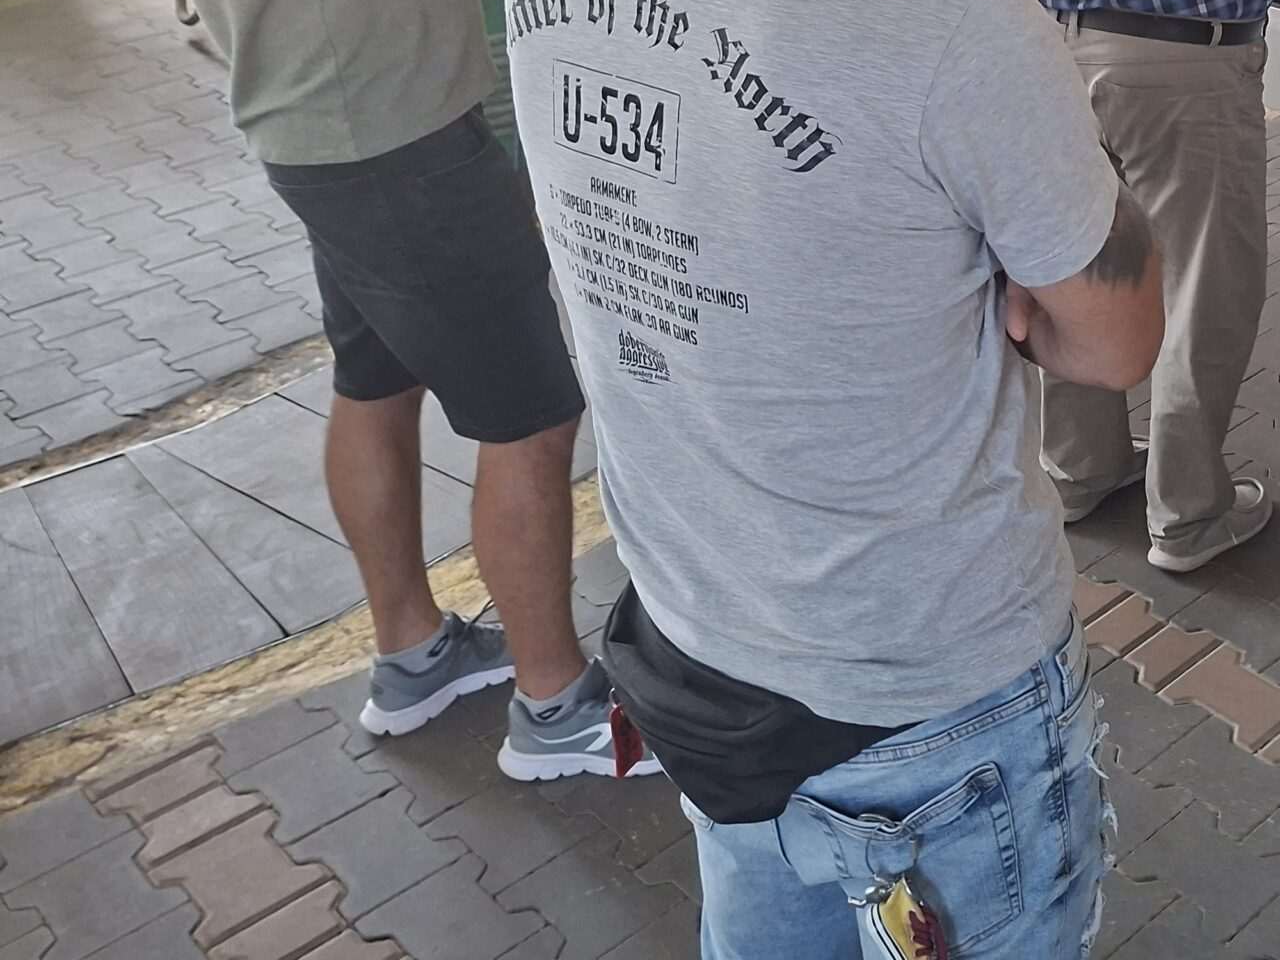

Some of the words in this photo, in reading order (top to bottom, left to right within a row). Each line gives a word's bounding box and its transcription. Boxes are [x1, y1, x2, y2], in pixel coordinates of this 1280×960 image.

[701, 27, 843, 173] North
[563, 74, 666, 172] U-534
[594, 227, 607, 245] CM
[628, 261, 650, 284] DECK
[650, 271, 669, 292] GUN
[678, 304, 698, 325] GUN
